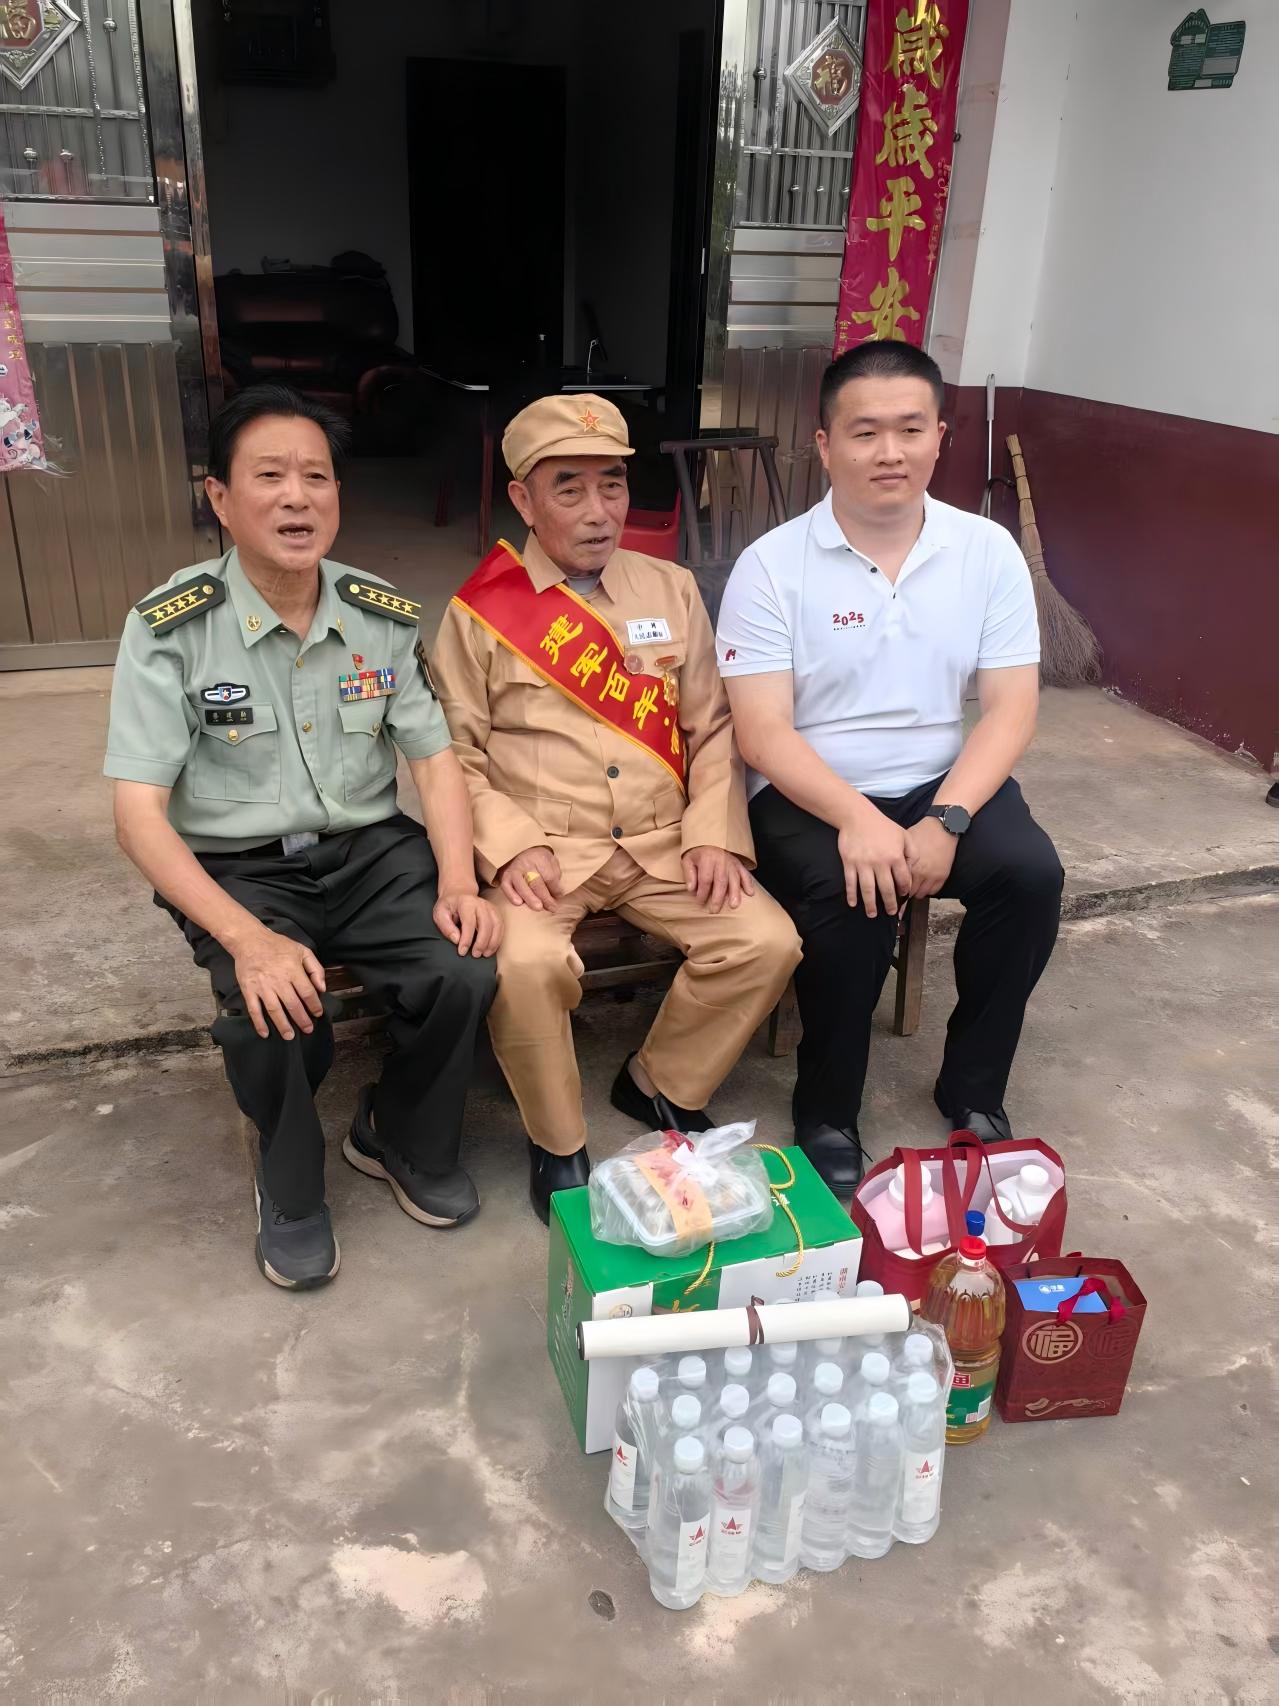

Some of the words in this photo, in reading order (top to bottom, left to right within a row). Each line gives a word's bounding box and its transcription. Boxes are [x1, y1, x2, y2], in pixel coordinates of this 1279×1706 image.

[813, 54, 848, 96] 福
[832, 611, 864, 626] 2025
[1030, 1325, 1076, 1358] 福
